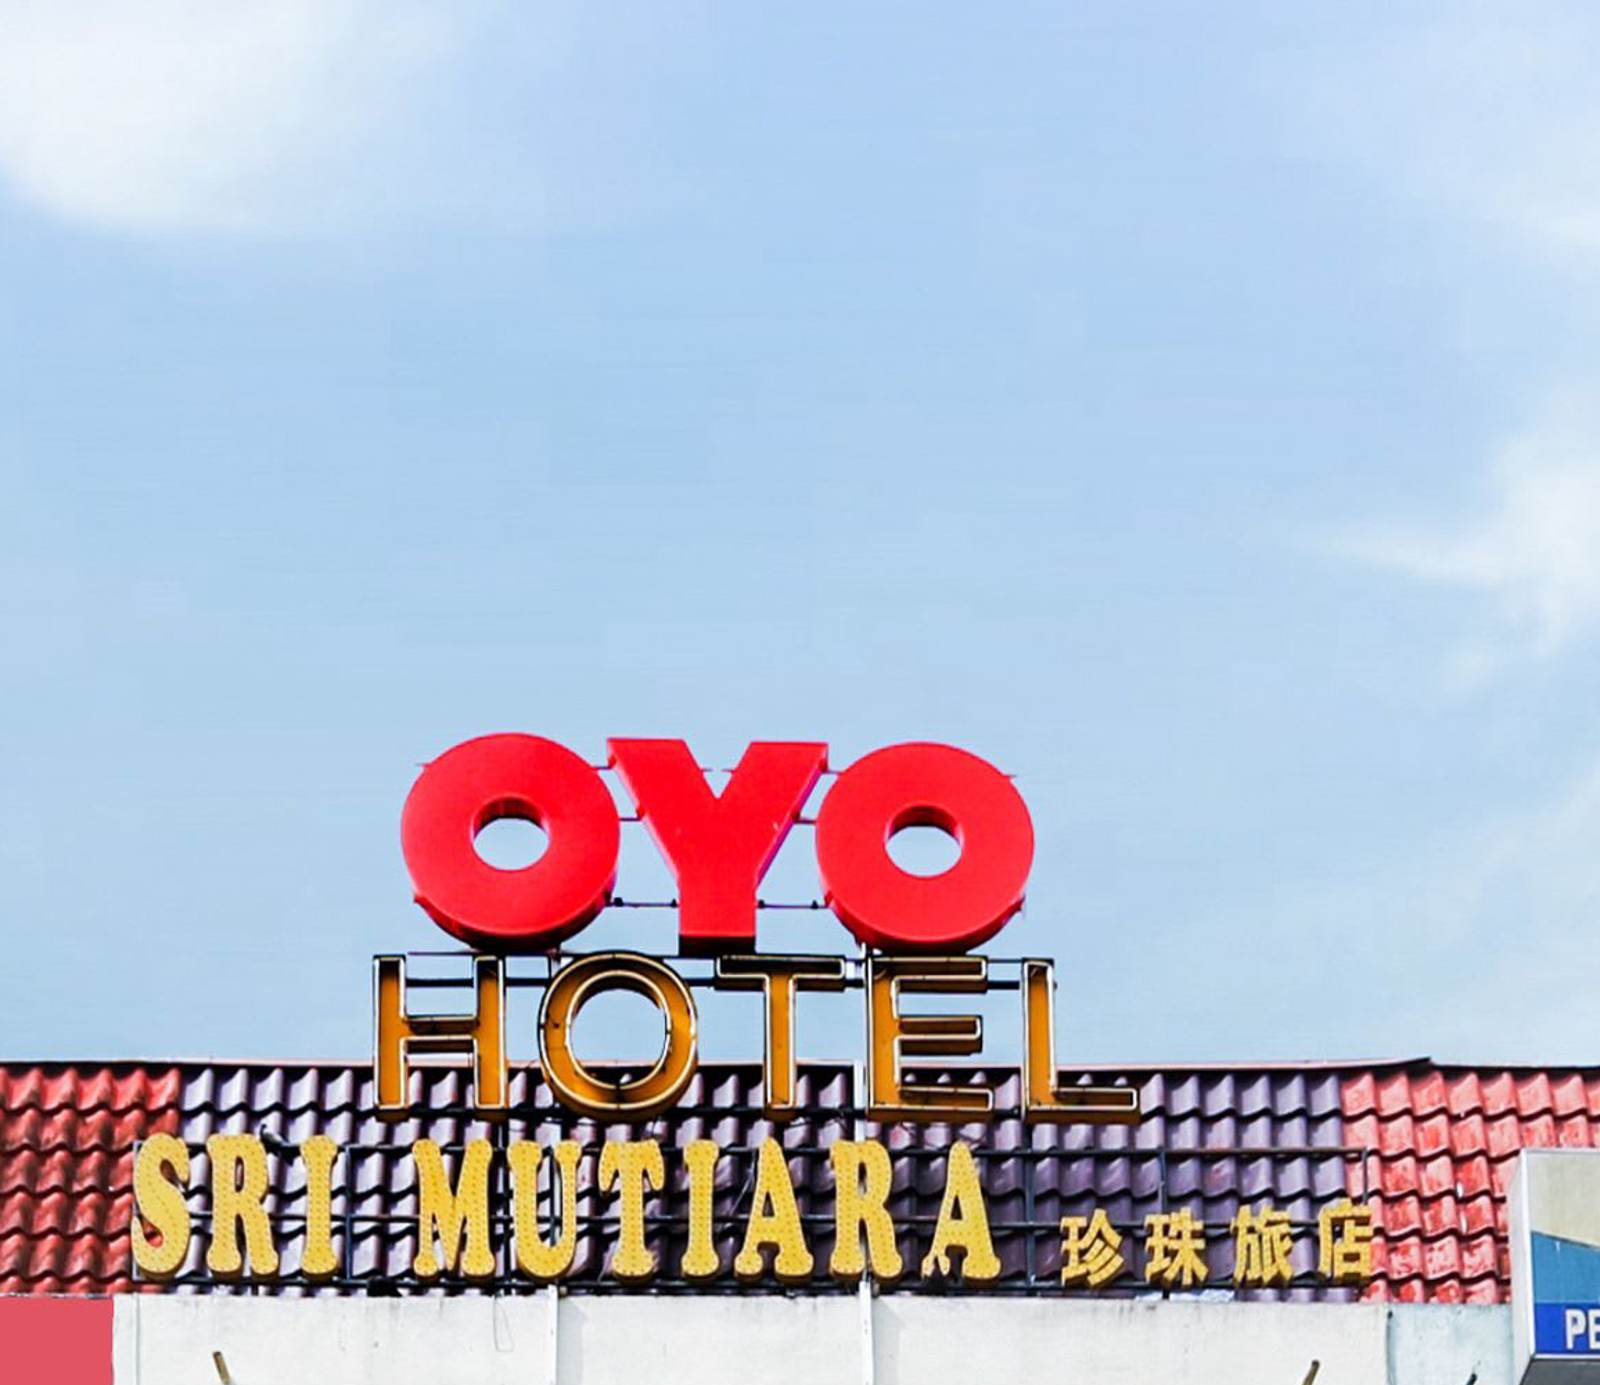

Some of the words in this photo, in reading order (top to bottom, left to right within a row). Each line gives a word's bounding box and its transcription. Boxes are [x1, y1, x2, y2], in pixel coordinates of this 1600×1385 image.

[400, 732, 1035, 953] OYO
[372, 951, 1138, 1121] HOTEL
[130, 1131, 339, 1280] SRI
[412, 1137, 1002, 1283] MUTIARA
[1059, 1197, 1375, 1289] 珍珠旅店
